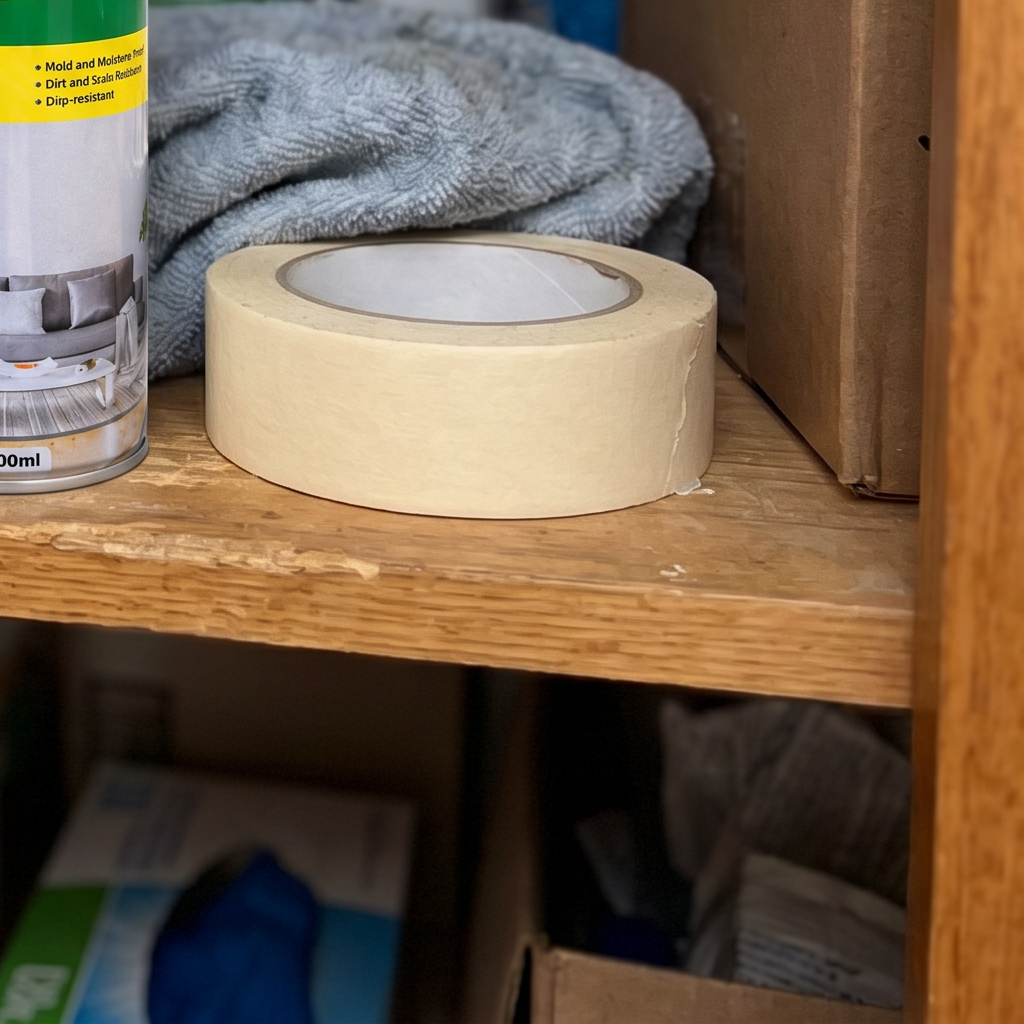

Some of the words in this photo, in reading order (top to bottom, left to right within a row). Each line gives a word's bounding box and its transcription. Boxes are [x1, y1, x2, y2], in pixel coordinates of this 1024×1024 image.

[45, 60, 73, 72] Mold
[75, 58, 95, 70] and
[45, 78, 67, 90] Dirt
[69, 75, 90, 88] and
